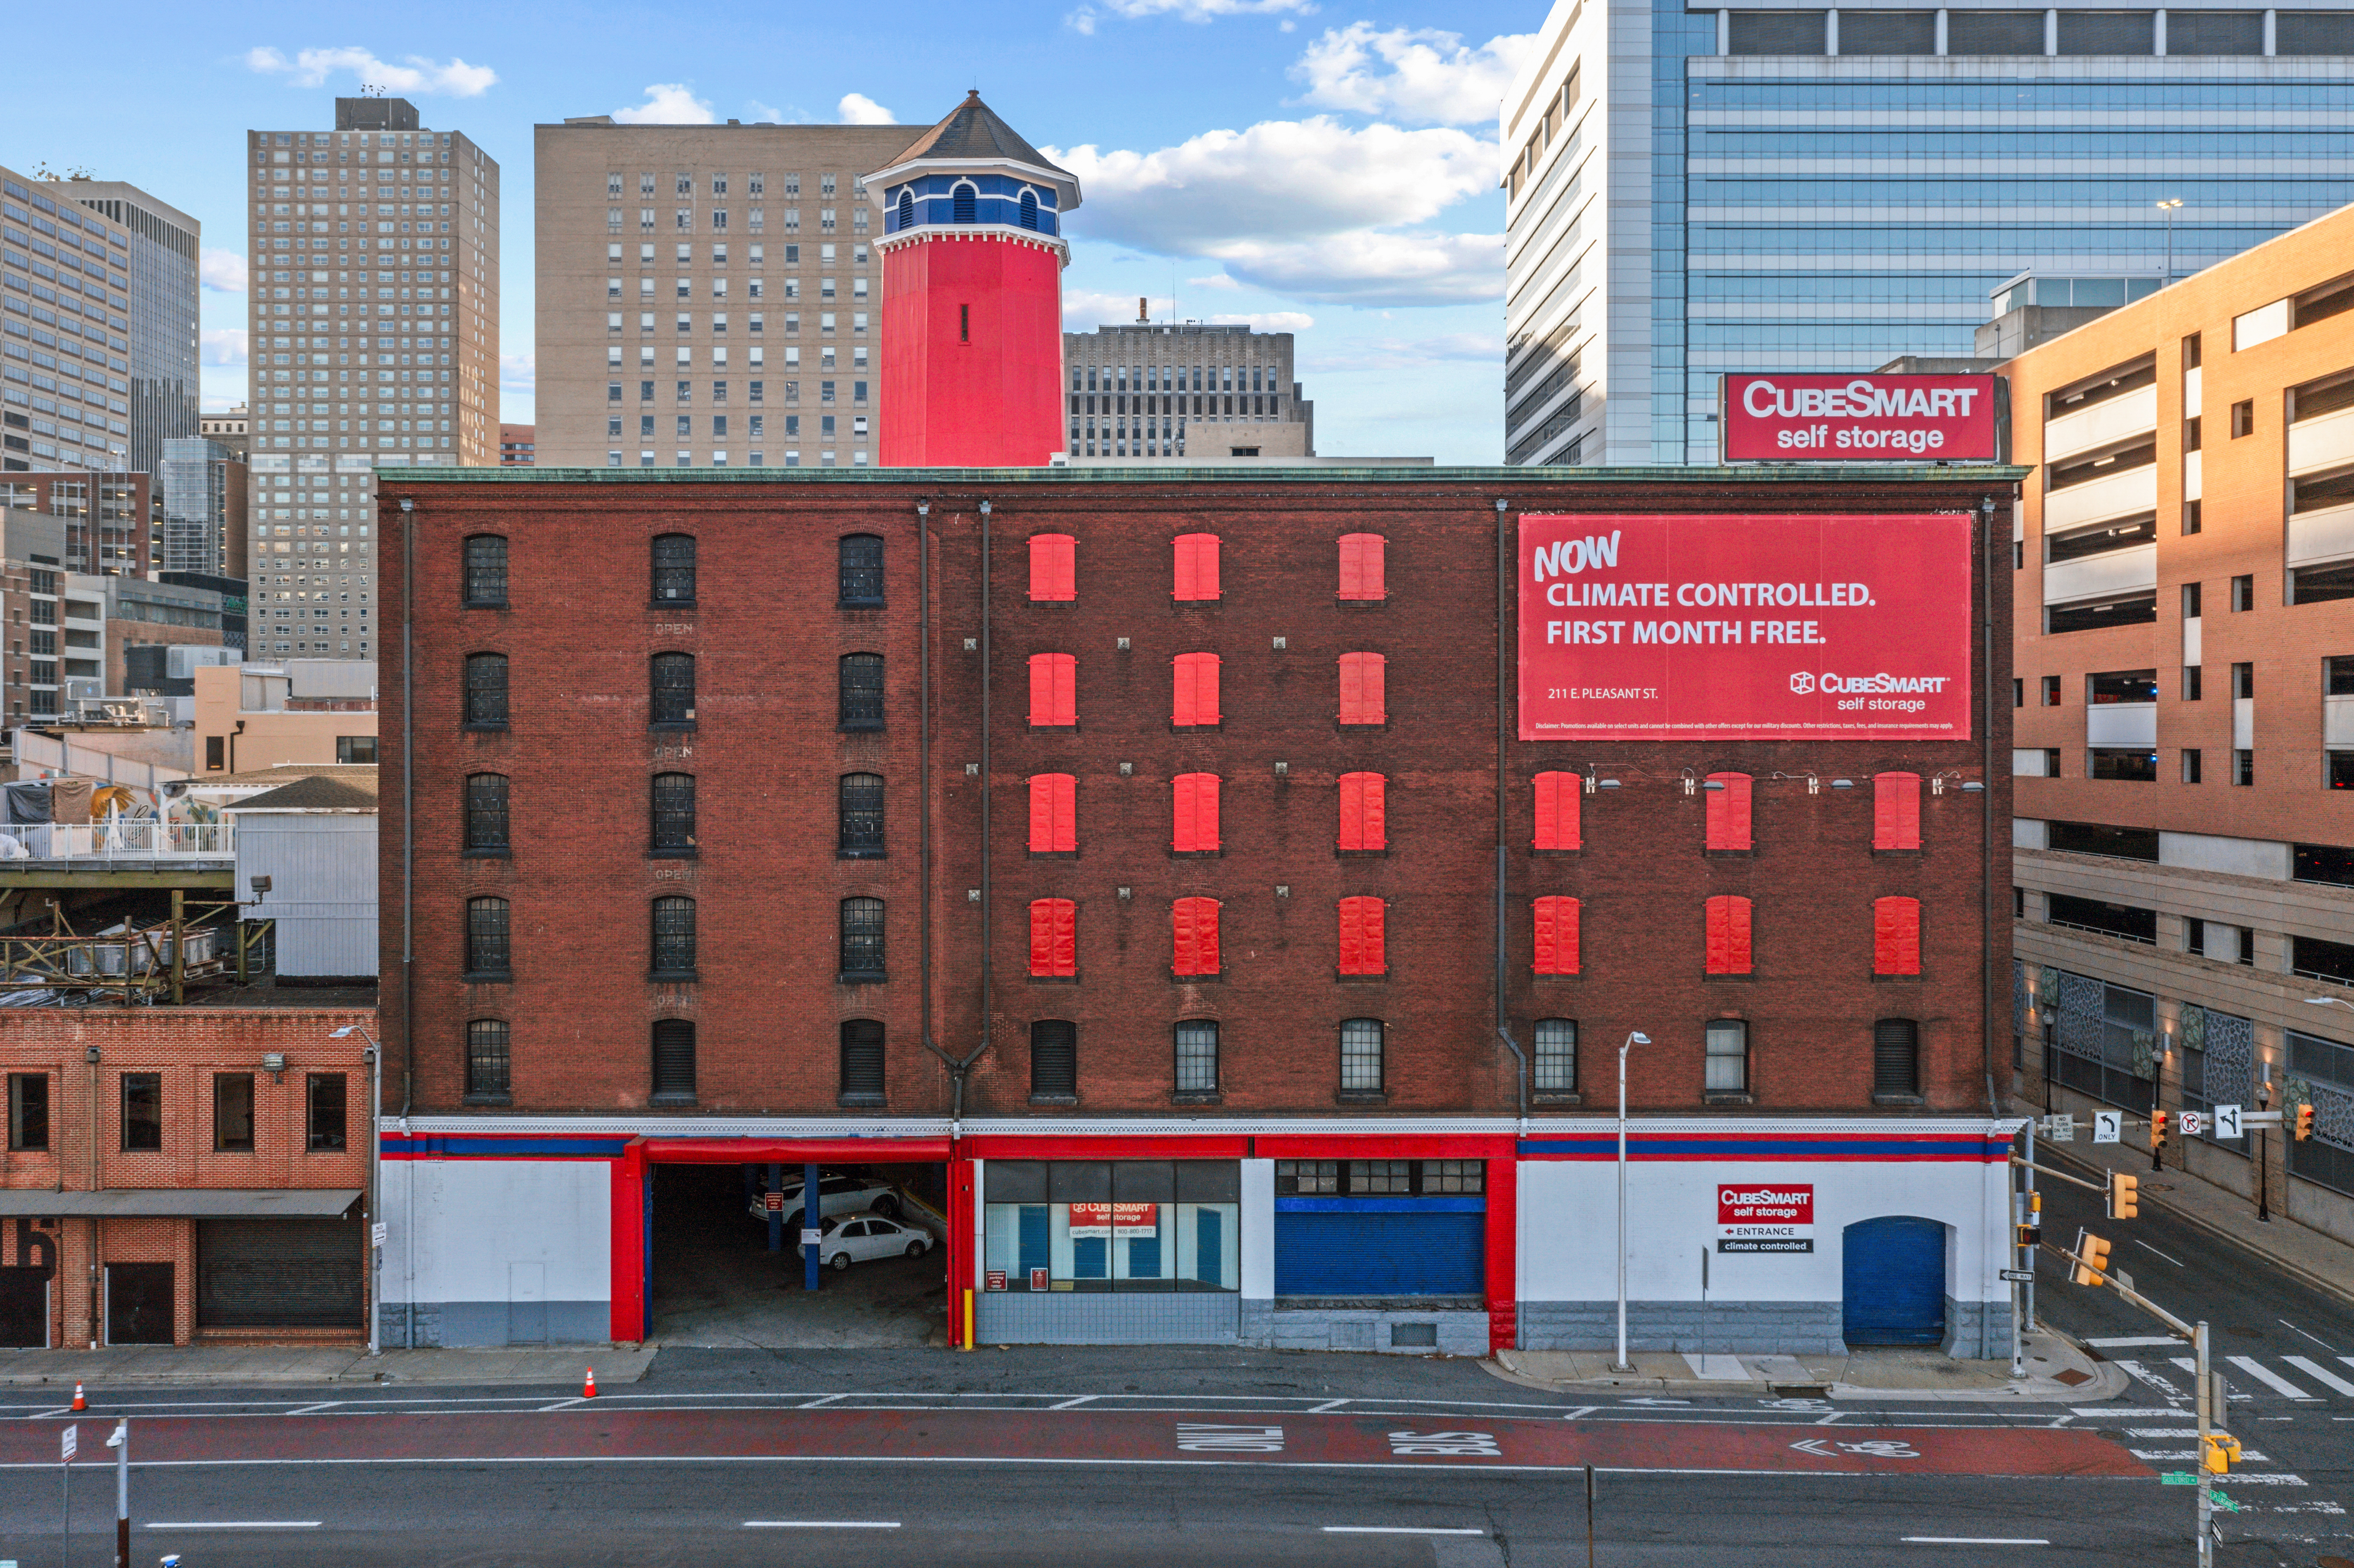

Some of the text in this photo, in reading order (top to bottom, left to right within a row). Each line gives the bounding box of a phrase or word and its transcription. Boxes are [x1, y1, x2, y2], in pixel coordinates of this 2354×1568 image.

[1778, 425, 1944, 454] self storage
[1535, 530, 1621, 582] NOW
[1547, 583, 1876, 607] CLIMATE CONTROLLED.
[655, 623, 692, 635] OPEN
[1548, 621, 1826, 644] FIRST MONTH FREE.
[1548, 688, 1658, 699] 211 E. PLEASANT ST.
[1837, 697, 1925, 712] self storage
[1734, 1207, 1797, 1218] self storage
[1388, 1431, 1502, 1455] BUS
